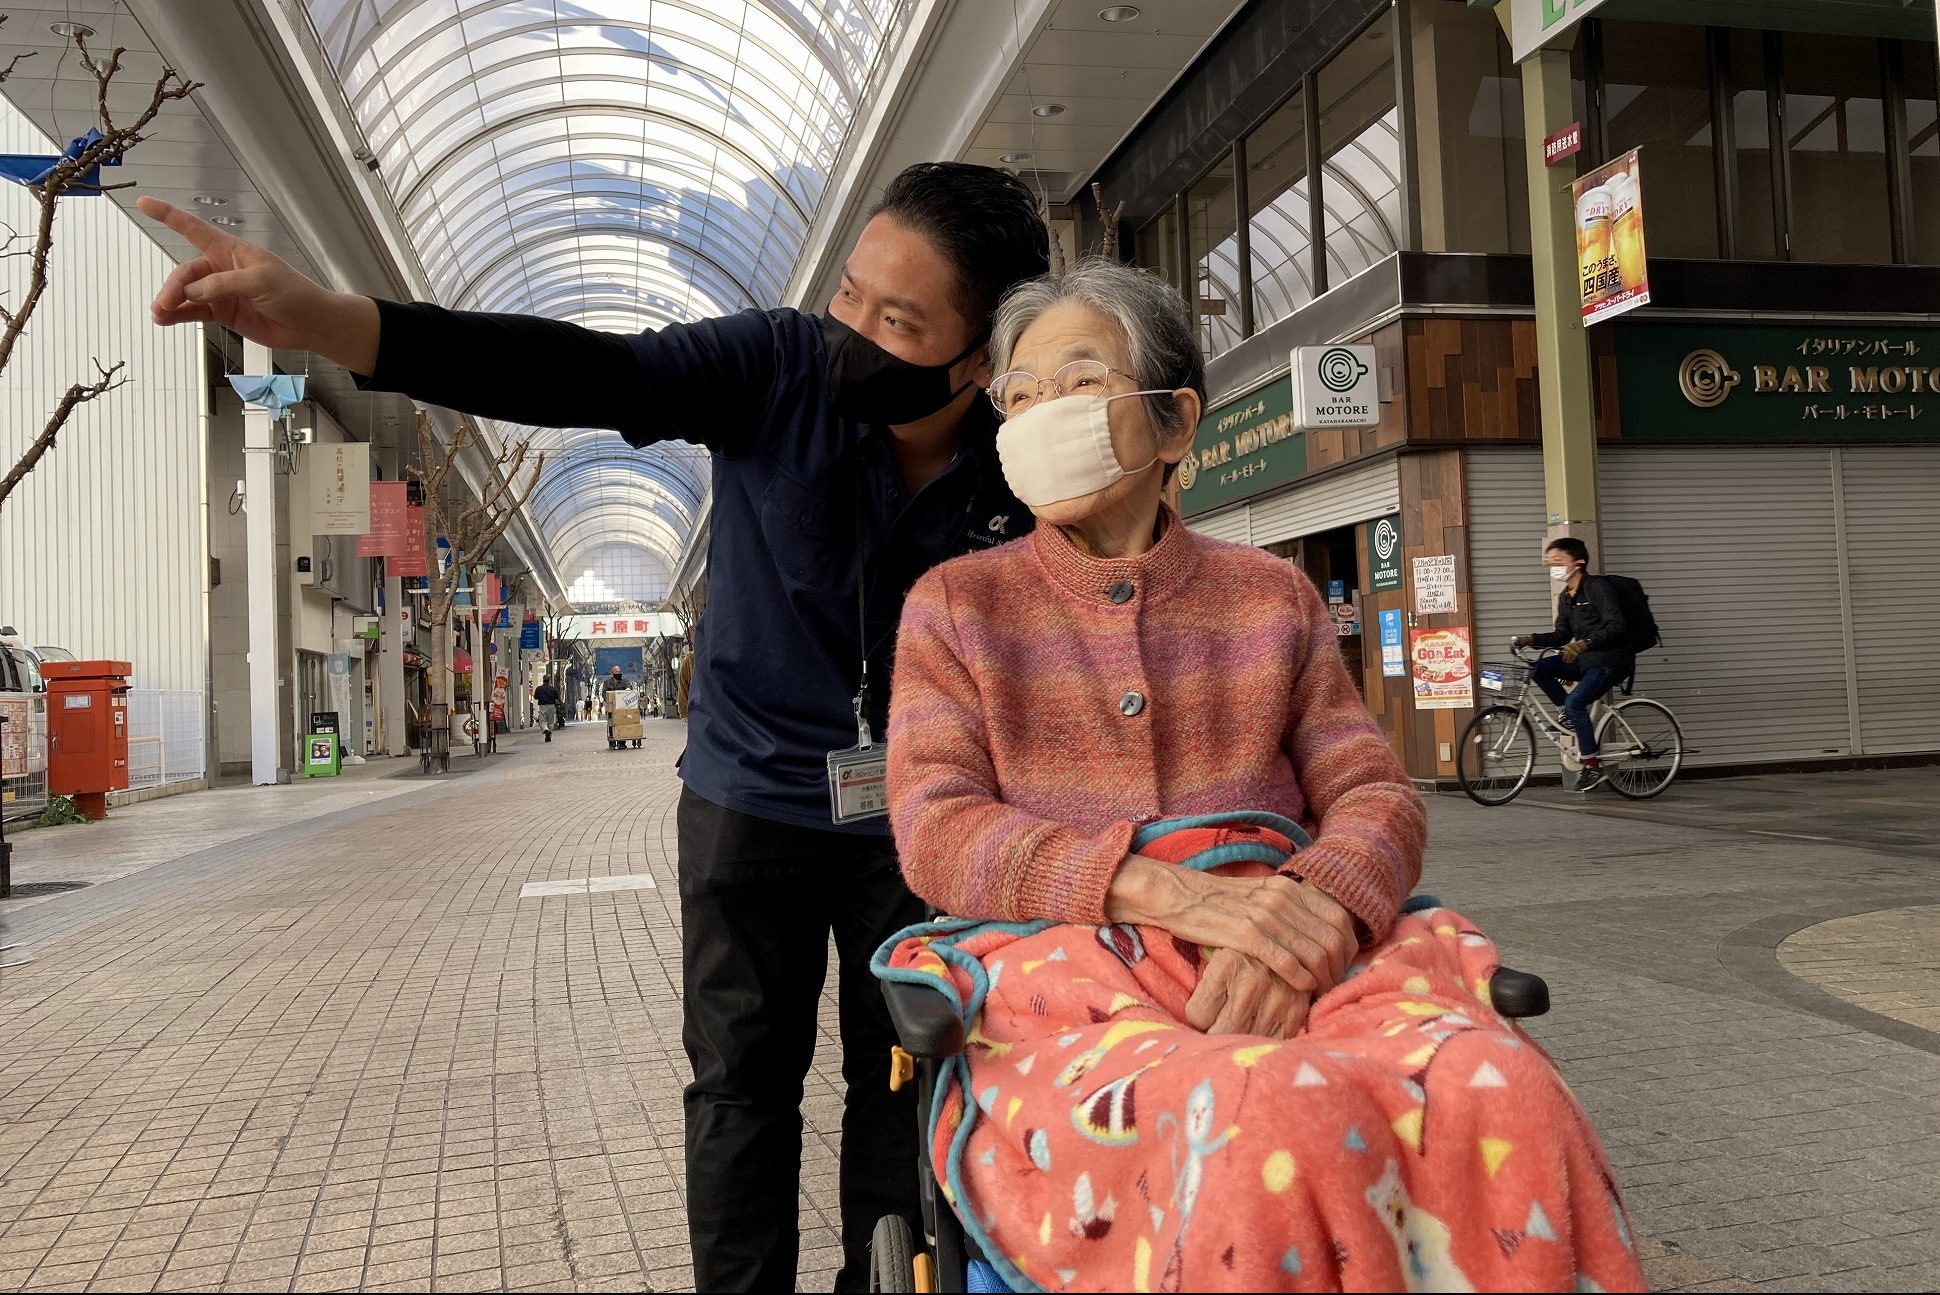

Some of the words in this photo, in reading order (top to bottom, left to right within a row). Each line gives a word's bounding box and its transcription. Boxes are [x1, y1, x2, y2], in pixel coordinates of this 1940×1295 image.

[1594, 289, 1635, 311] アサヒスーパードライ
[1797, 338, 1920, 356] イタリアンバール
[1753, 365, 1833, 392] BAR
[1316, 405, 1368, 416] MOTORE
[1201, 440, 1231, 470] BAR
[966, 529, 995, 545] Heartful
[1381, 561, 1391, 569] BAR
[1374, 568, 1398, 580] MOTORE
[592, 620, 649, 634] 片原町
[1417, 648, 1435, 660] Go
[1444, 646, 1465, 659] Eat
